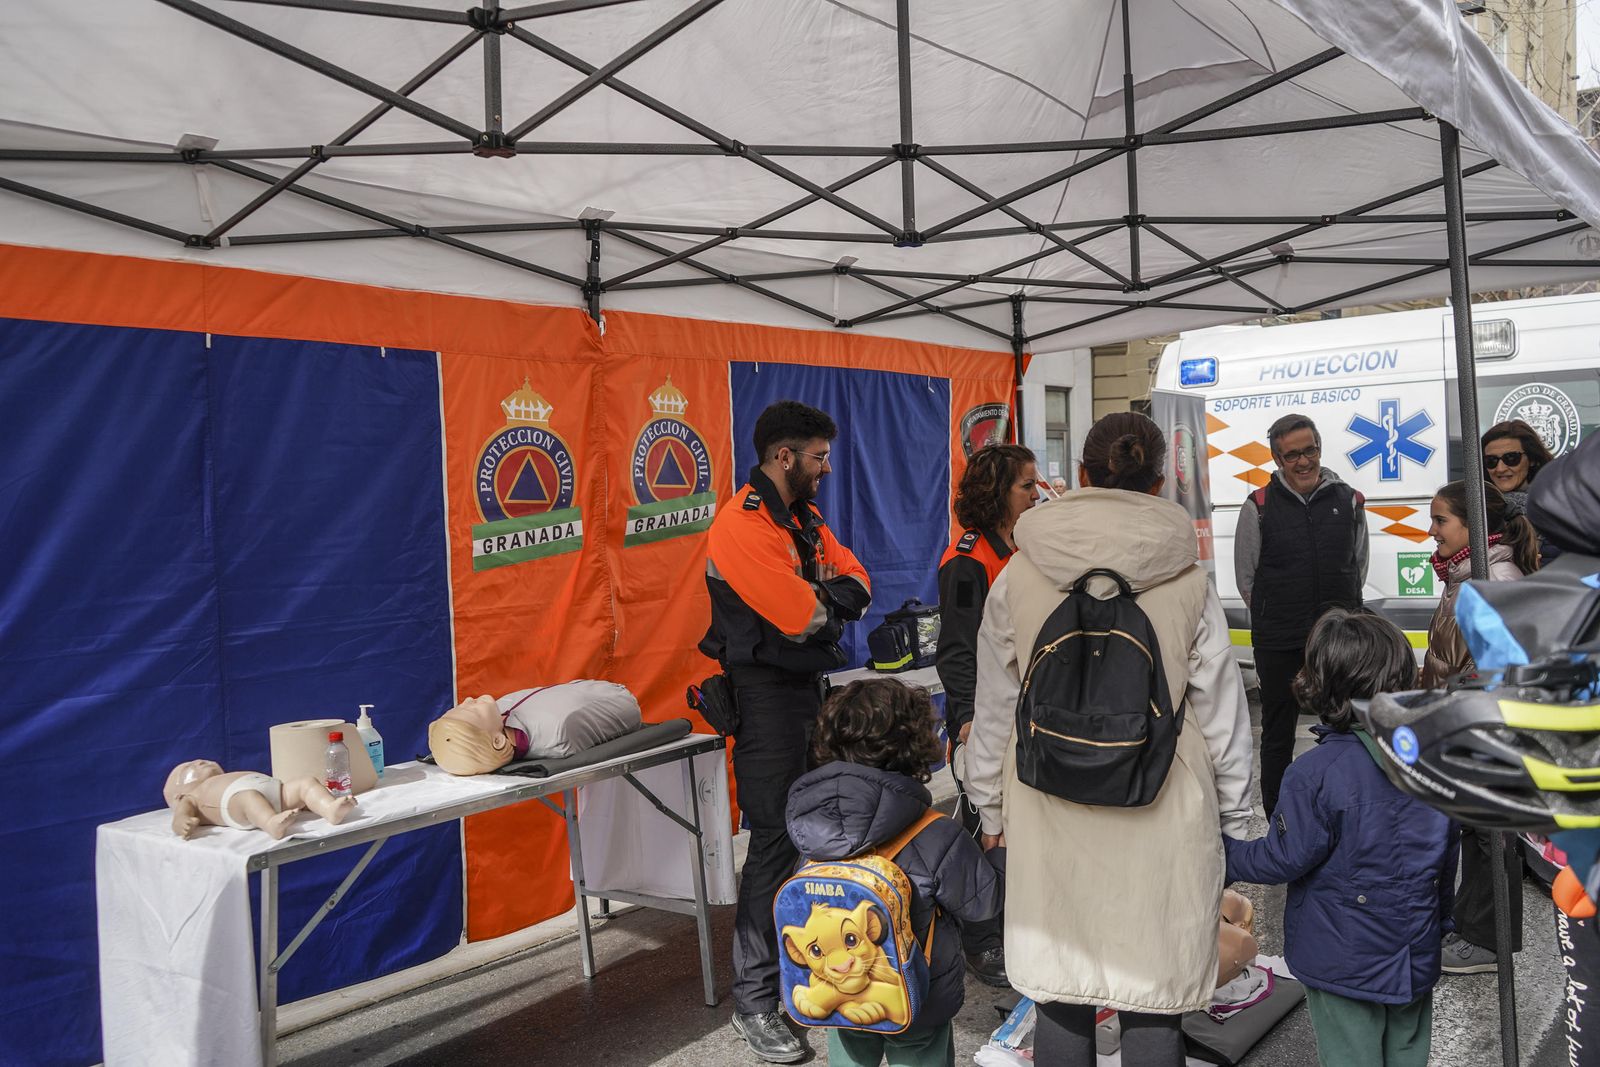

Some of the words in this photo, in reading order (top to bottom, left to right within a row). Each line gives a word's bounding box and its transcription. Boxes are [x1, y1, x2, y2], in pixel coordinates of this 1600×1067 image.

[1259, 349, 1399, 381] PROTECCION
[1213, 396, 1271, 412] SOPORTE
[1275, 392, 1306, 407] VITAL
[1310, 388, 1361, 404] BASICO
[1542, 387, 1557, 397] DE
[1556, 395, 1577, 437] GRANADA
[480, 429, 554, 493] PROTECCION
[554, 450, 573, 495] CIVIL
[633, 418, 689, 478] PROTECCION
[690, 440, 709, 480] CIVIL
[634, 505, 710, 533] GRANADA
[482, 522, 575, 555] GRANADA
[1405, 587, 1427, 595] DESA
[804, 882, 845, 897] SIMBA
[1562, 955, 1576, 967] a
